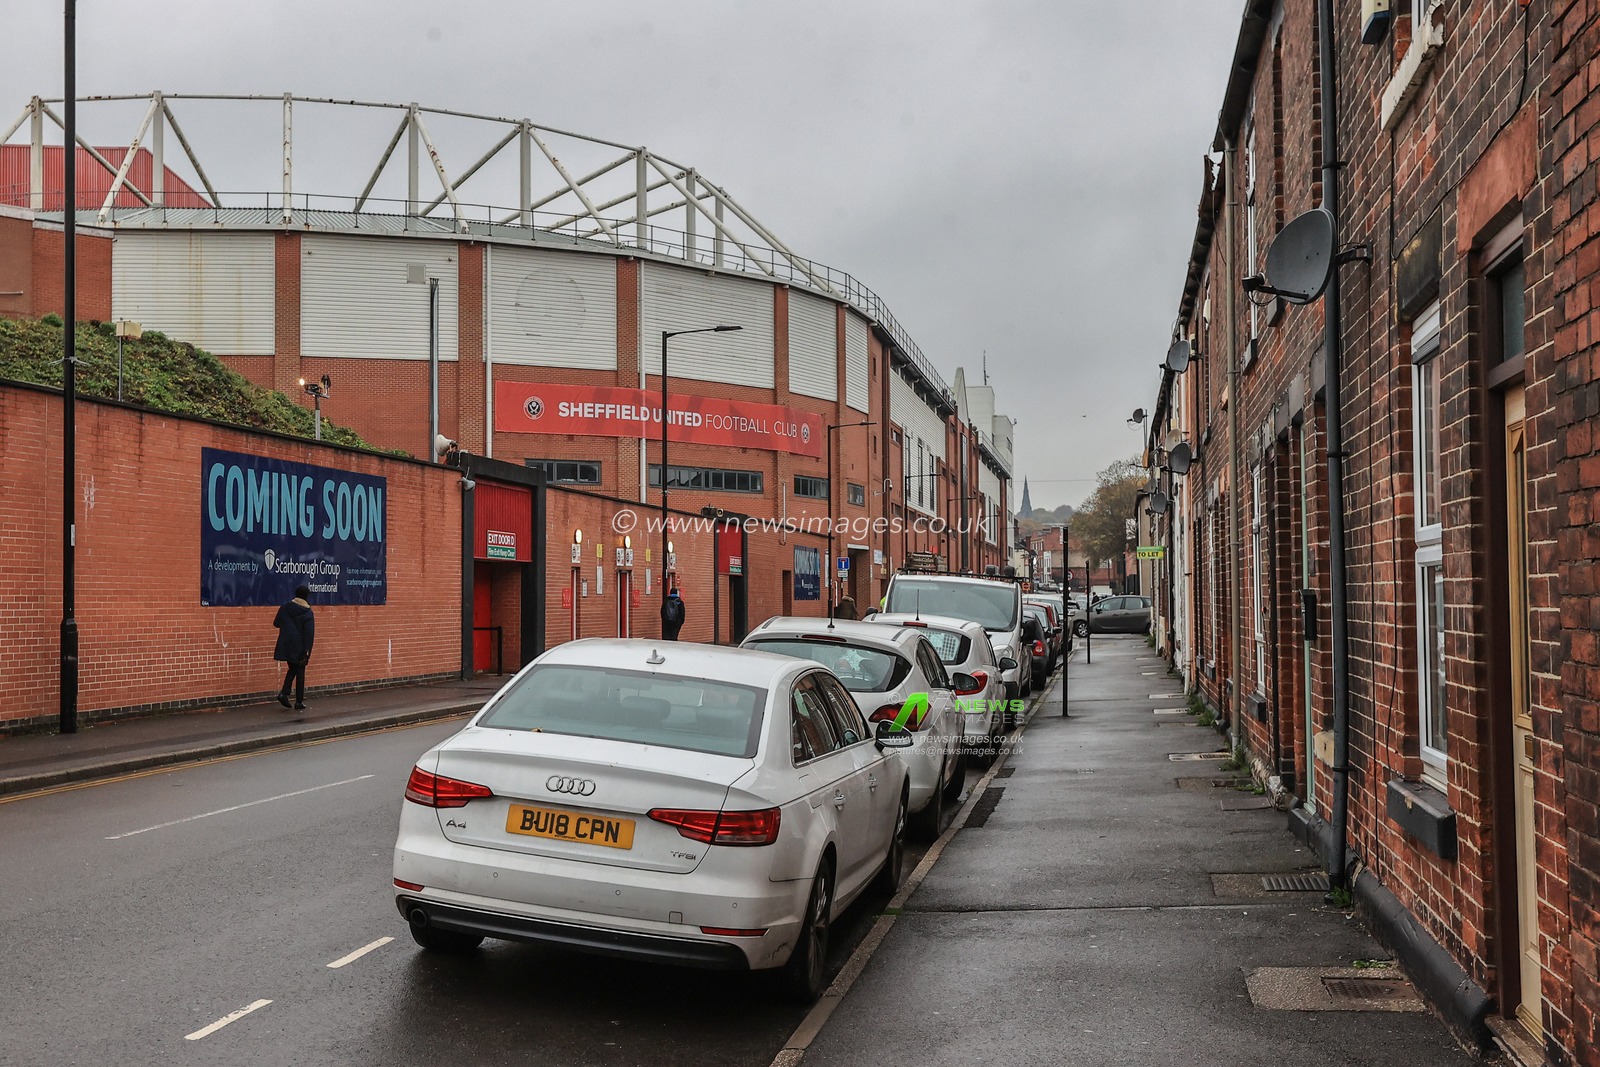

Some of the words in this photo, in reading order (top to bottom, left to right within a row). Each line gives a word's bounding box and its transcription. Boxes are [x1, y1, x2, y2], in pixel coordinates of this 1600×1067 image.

[558, 401, 650, 421] SHEFFIELD
[652, 407, 703, 427] UNITED
[705, 413, 770, 434] FOOTBALL
[773, 420, 797, 438] CLUB
[208, 462, 315, 538] COMING
[322, 479, 382, 543] SOON
[208, 559, 213, 570] A
[214, 559, 251, 574] development
[251, 560, 259, 575] by
[275, 557, 319, 579] Scarborough
[320, 560, 340, 579] Group
[308, 582, 338, 593] International
[445, 817, 467, 829] A4
[520, 809, 570, 836] BU18
[575, 817, 620, 843] CPN
